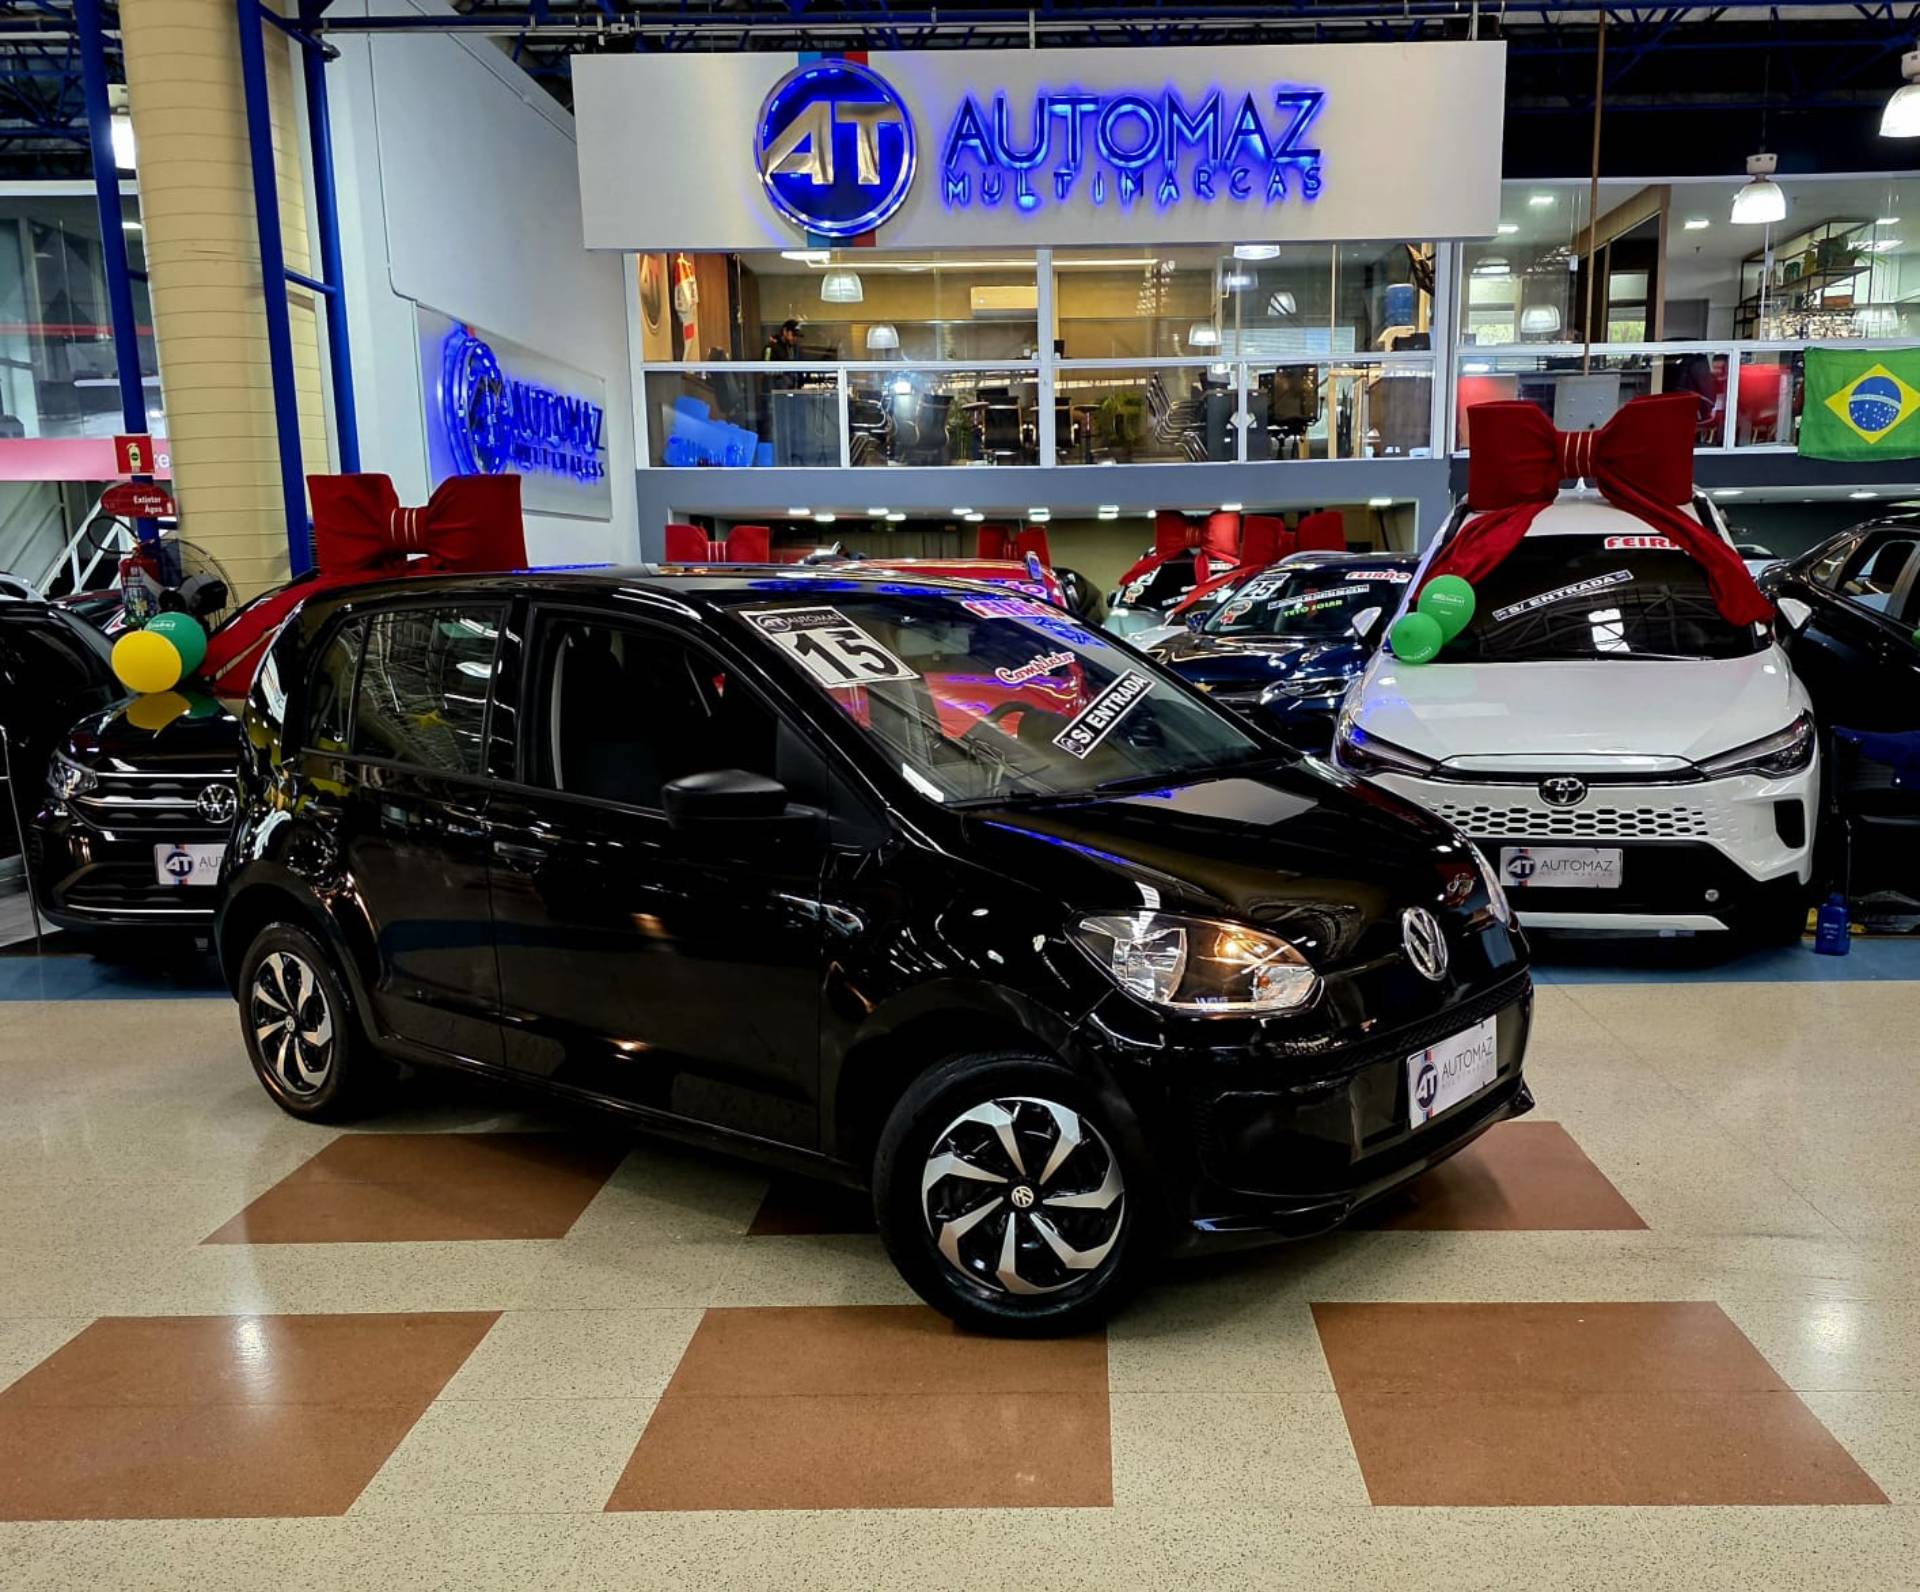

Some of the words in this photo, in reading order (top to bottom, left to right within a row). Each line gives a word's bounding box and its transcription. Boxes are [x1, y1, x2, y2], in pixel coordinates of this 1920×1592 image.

[945, 91, 1325, 167] AUTOMAZ
[945, 167, 1321, 202] MULTIMARCAS
[507, 380, 605, 452] AUTOMAZ
[1606, 536, 1679, 548] FEIR
[1240, 581, 1277, 597] 25
[1529, 576, 1615, 608] ENTRADA
[794, 629, 900, 680] 15
[1071, 724, 1095, 744] S/
[1085, 675, 1148, 729] ENTRADA
[1540, 859, 1613, 872] AUTOMAZ
[1442, 1036, 1493, 1078] AUTOMAZ
